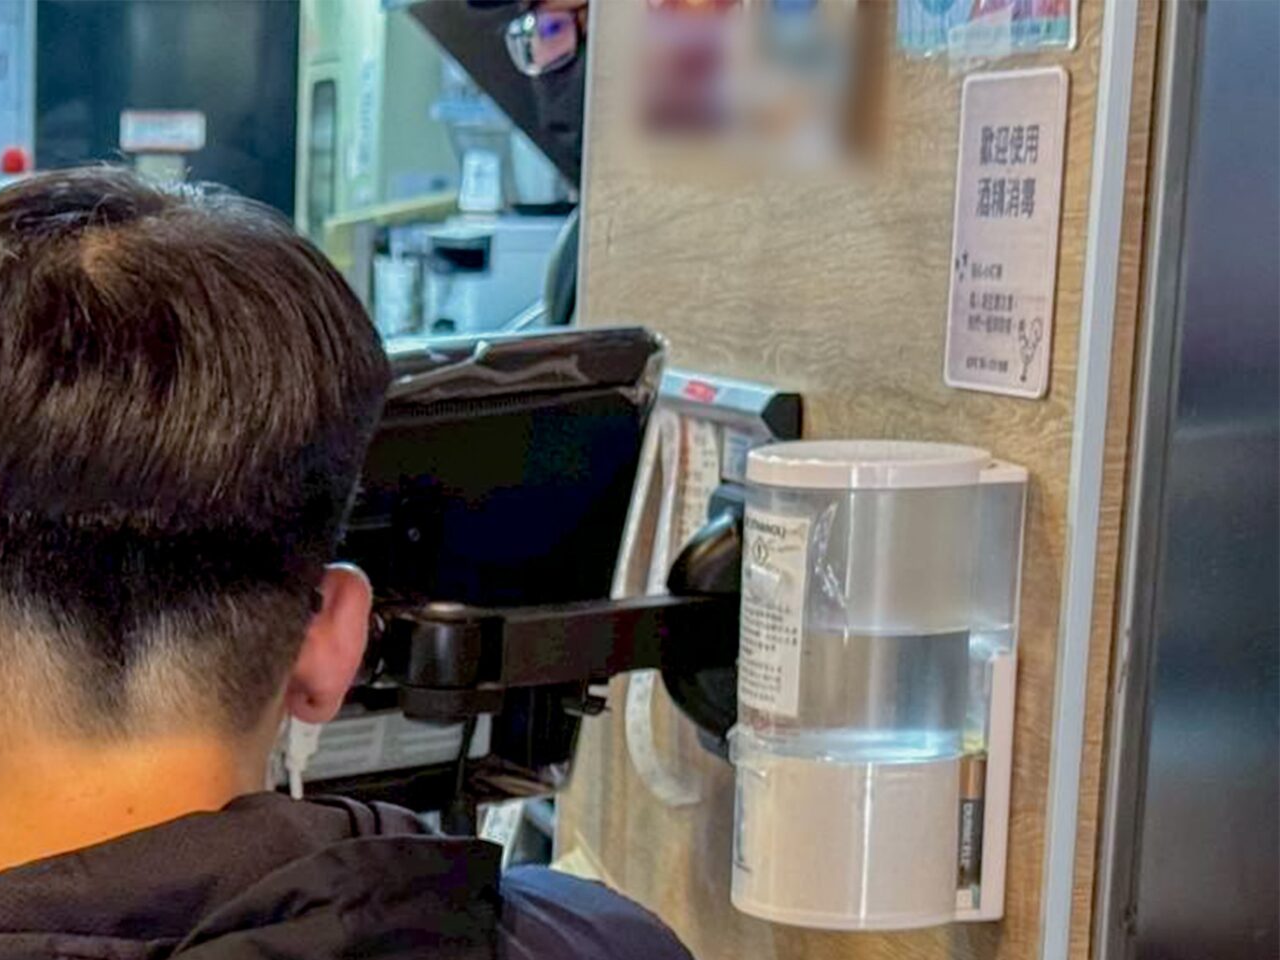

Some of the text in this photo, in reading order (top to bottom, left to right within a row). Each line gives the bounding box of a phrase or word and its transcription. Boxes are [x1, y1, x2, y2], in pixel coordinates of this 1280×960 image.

[980, 124, 1040, 166] 歡迎使用
[976, 177, 1036, 219] 酒精消毒
